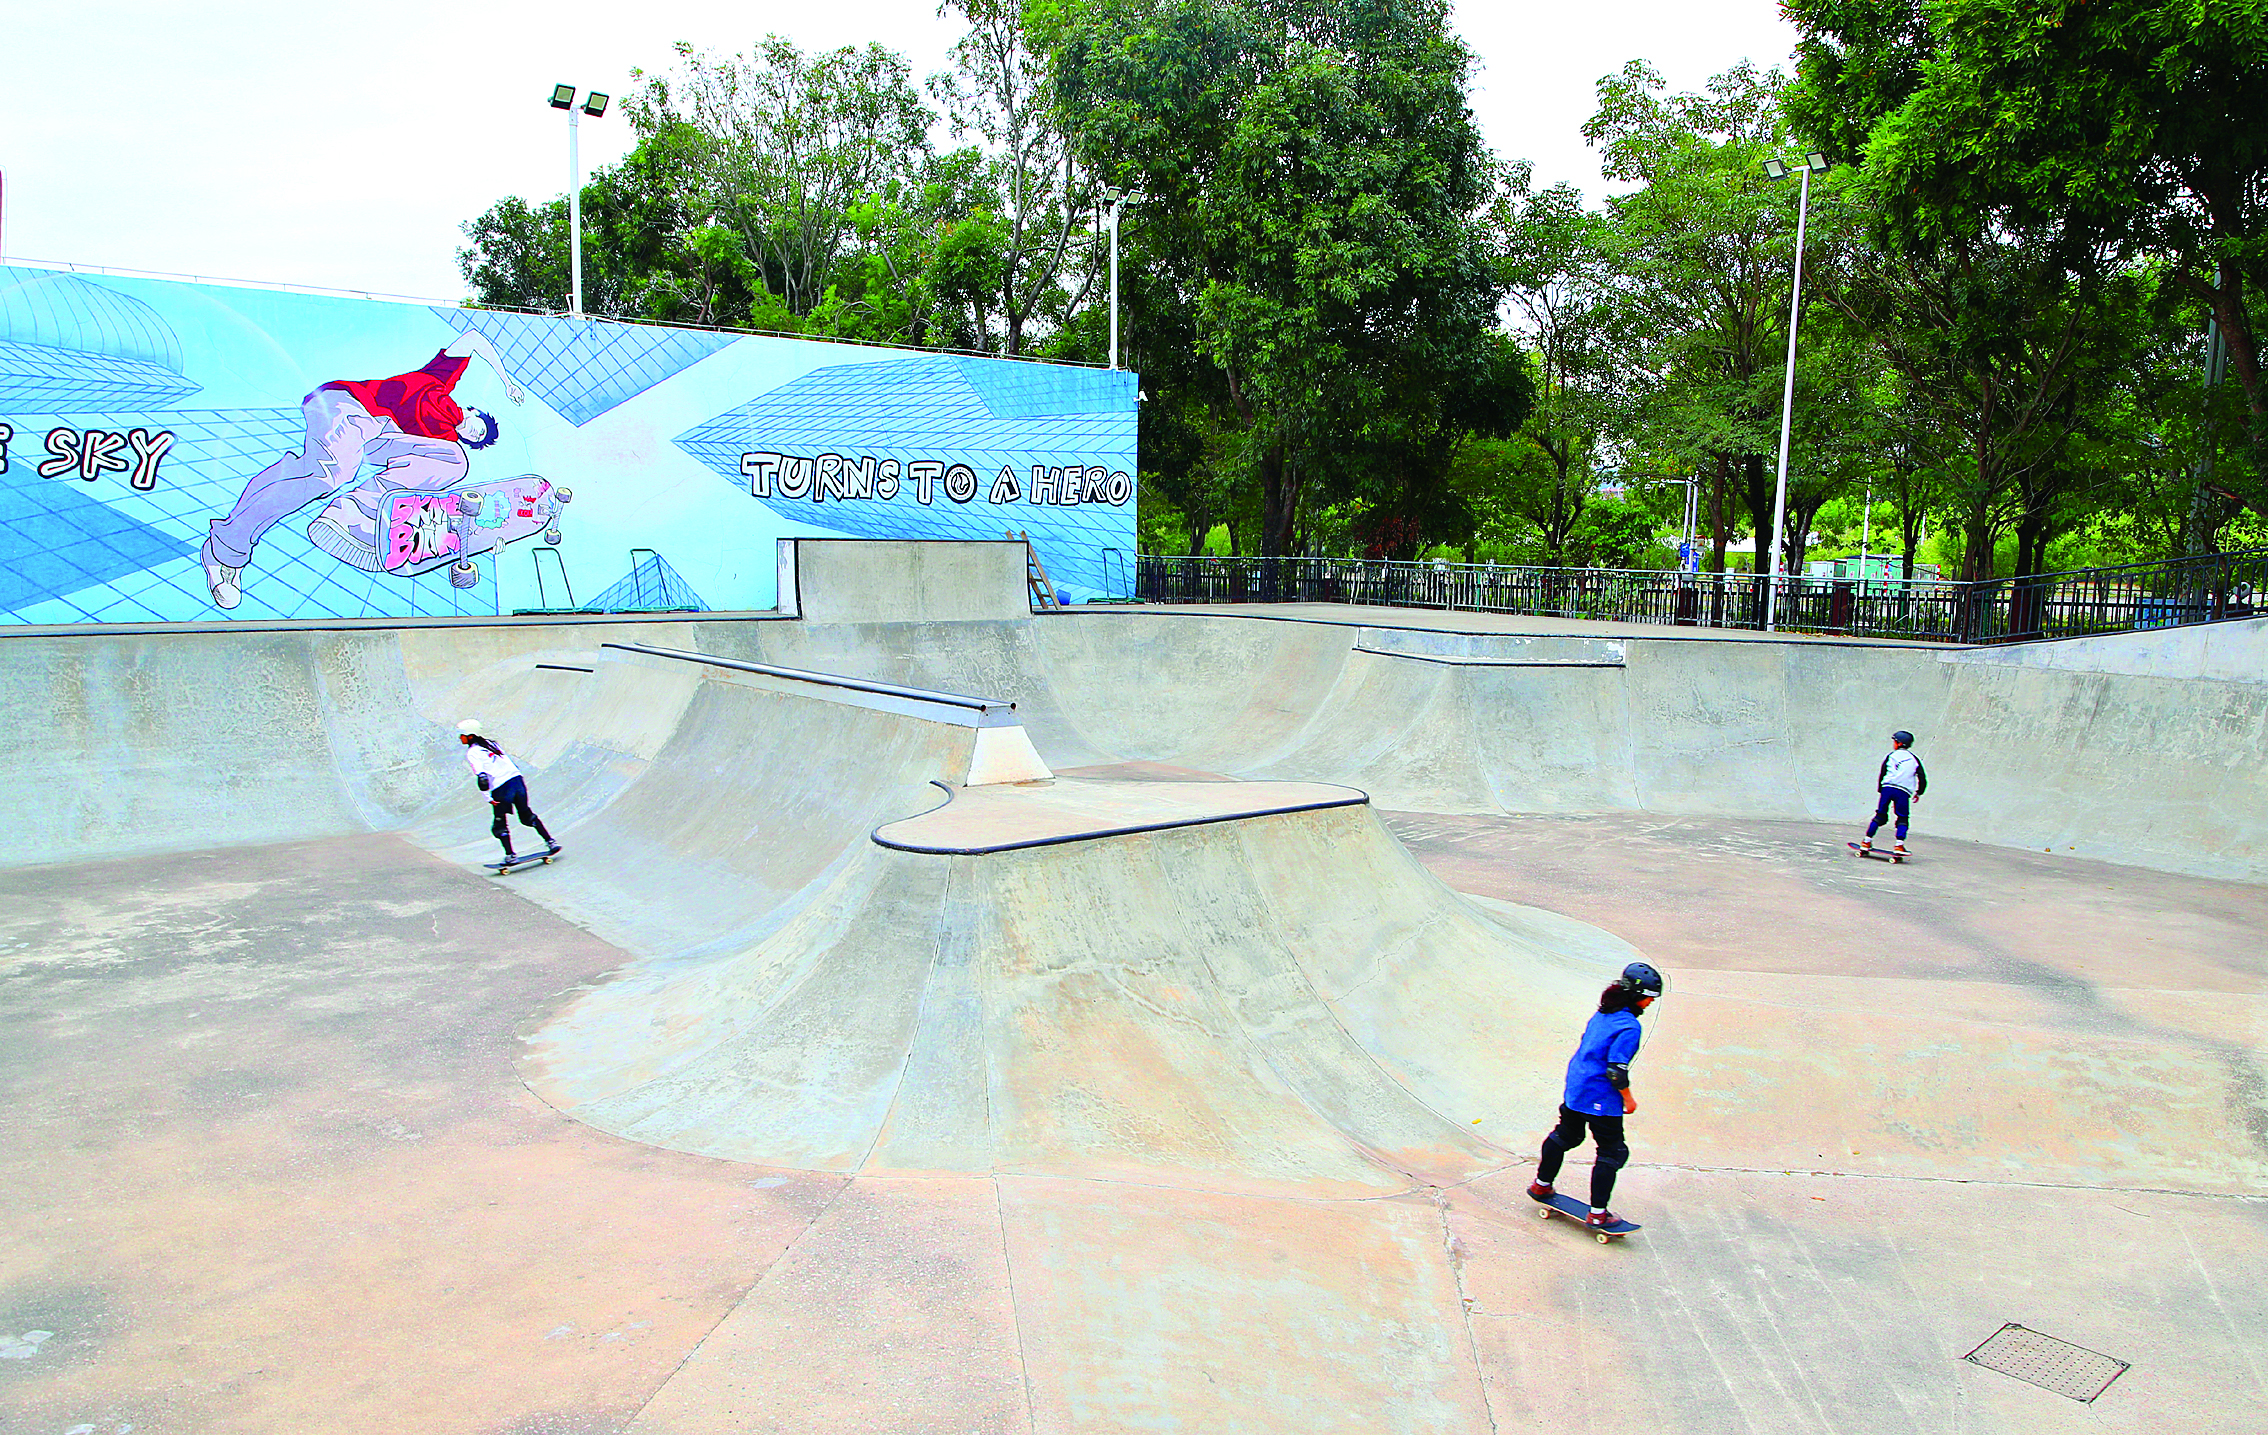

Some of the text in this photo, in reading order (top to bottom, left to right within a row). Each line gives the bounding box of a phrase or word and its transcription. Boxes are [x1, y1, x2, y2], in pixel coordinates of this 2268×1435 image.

[37, 427, 177, 490] SKY
[740, 451, 1132, 507] TURNS TO A HERO
